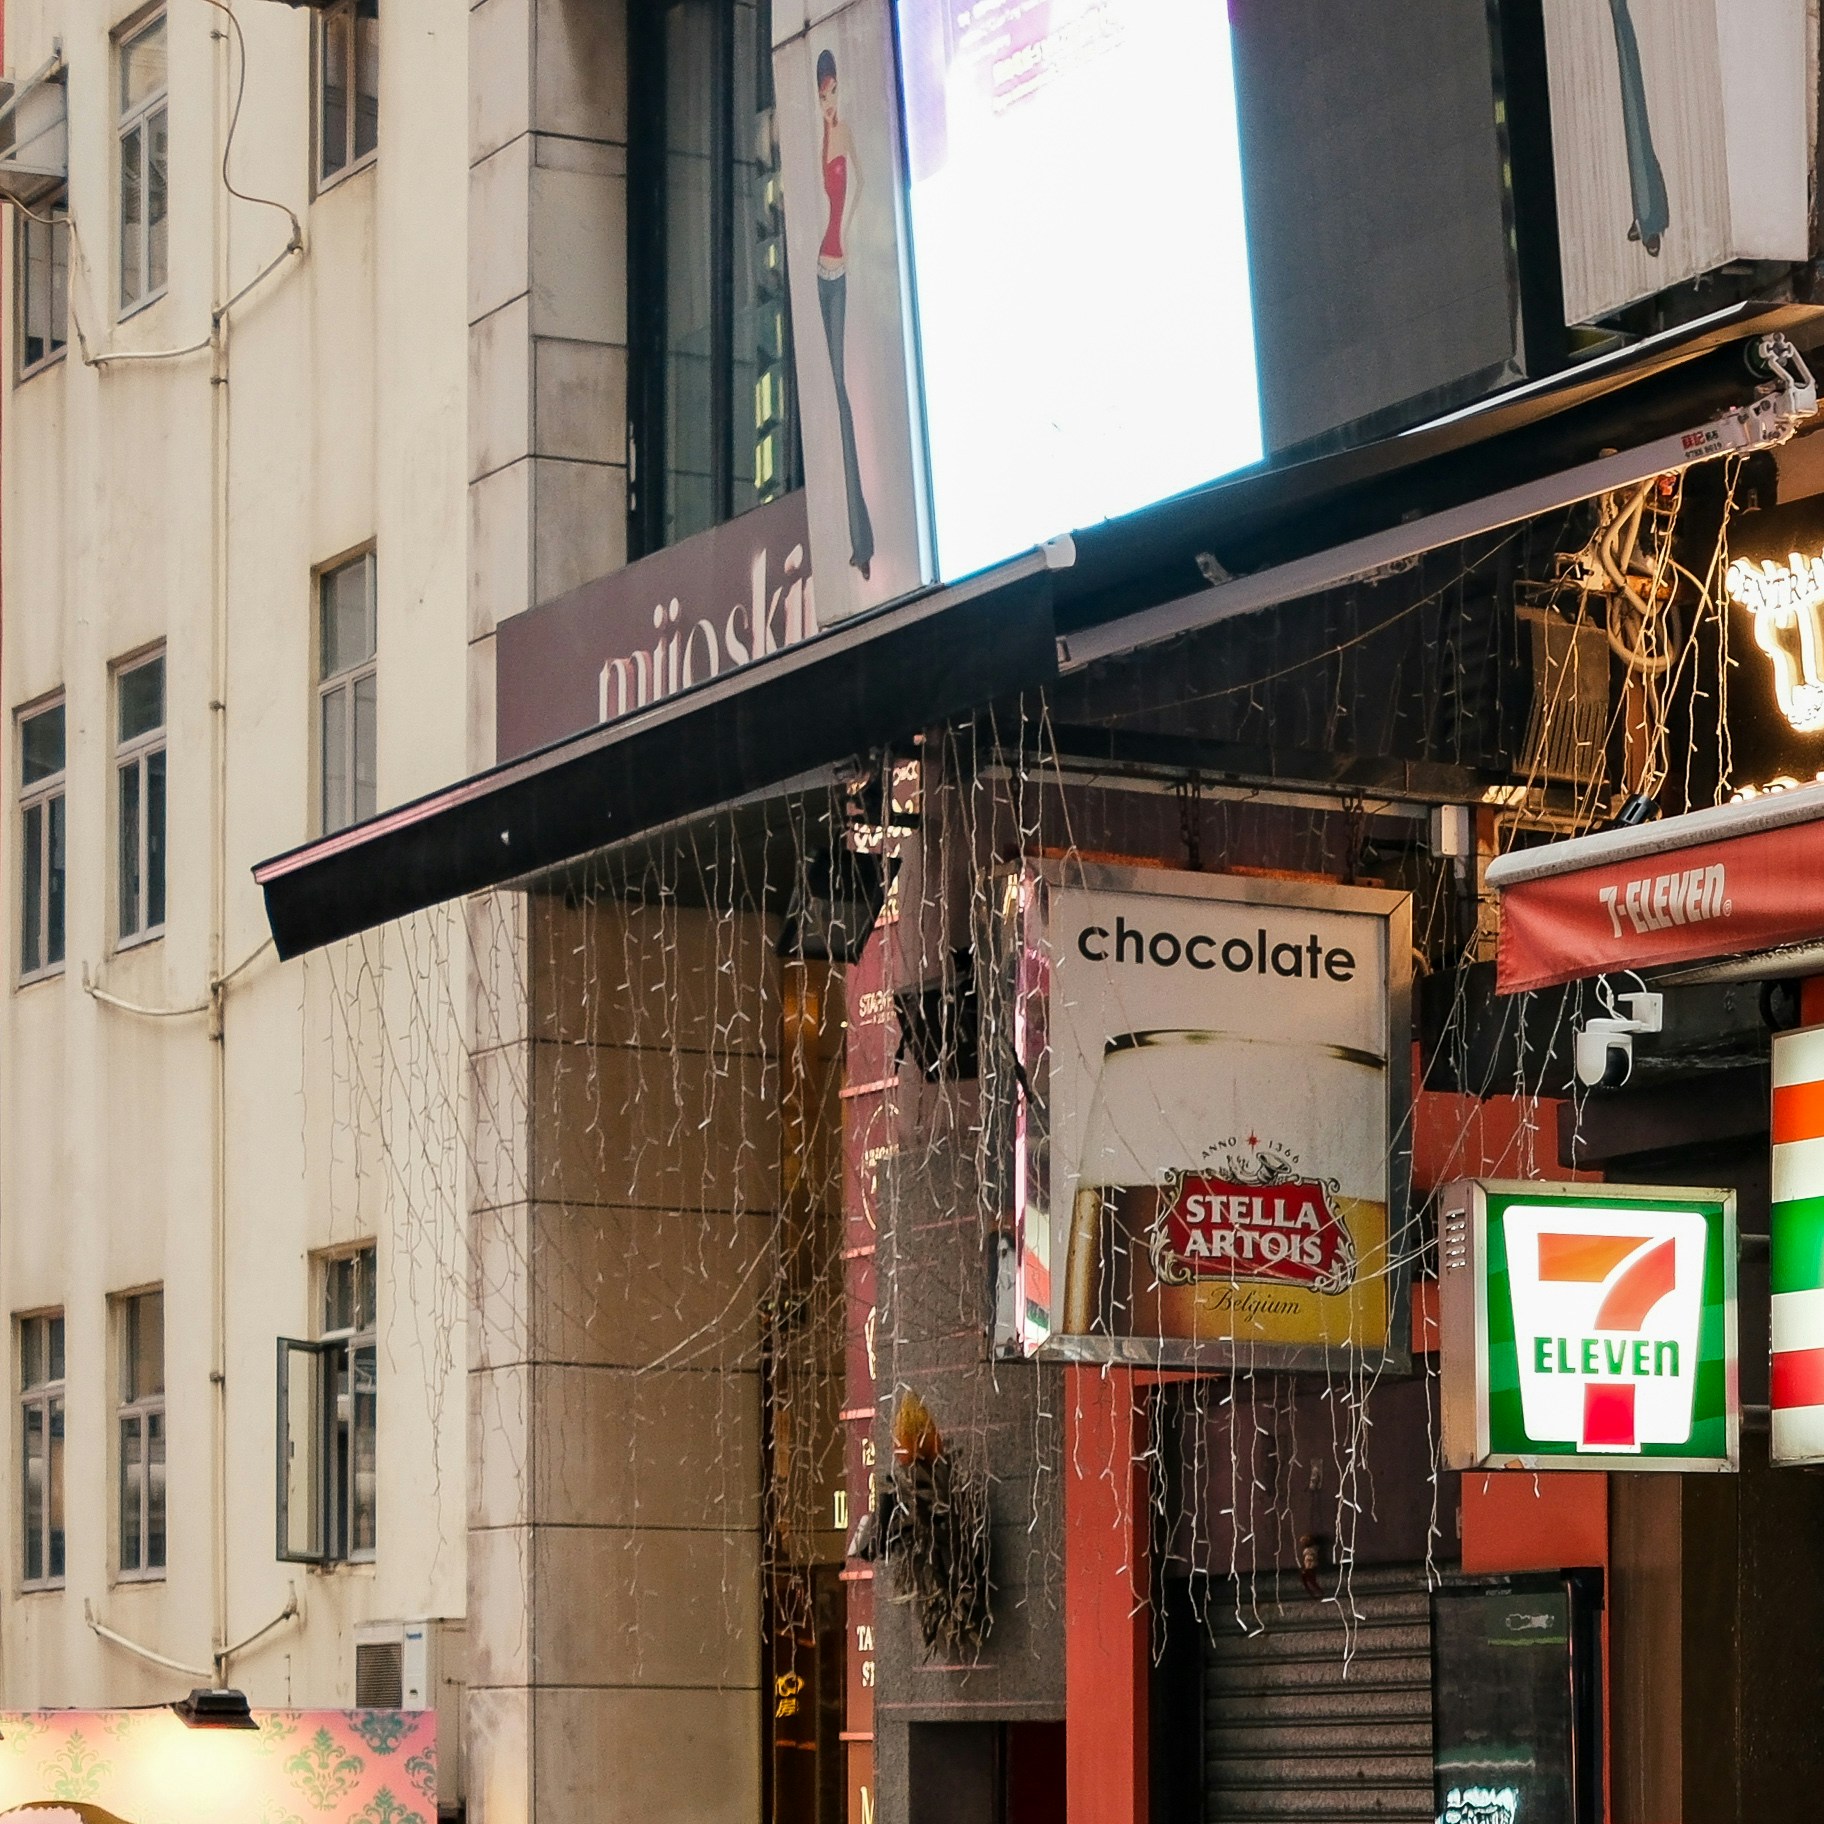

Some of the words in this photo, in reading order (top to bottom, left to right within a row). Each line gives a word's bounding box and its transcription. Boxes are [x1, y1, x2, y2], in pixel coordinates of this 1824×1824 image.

[1077, 916, 1356, 982] chocolate
[1201, 1136, 1237, 1162] ANNO
[1185, 1194, 1322, 1231] STELLA
[1183, 1229, 1325, 1265] ARTOIS
[1204, 1286, 1301, 1322] Belgium
[1537, 1232, 1675, 1445] 7
